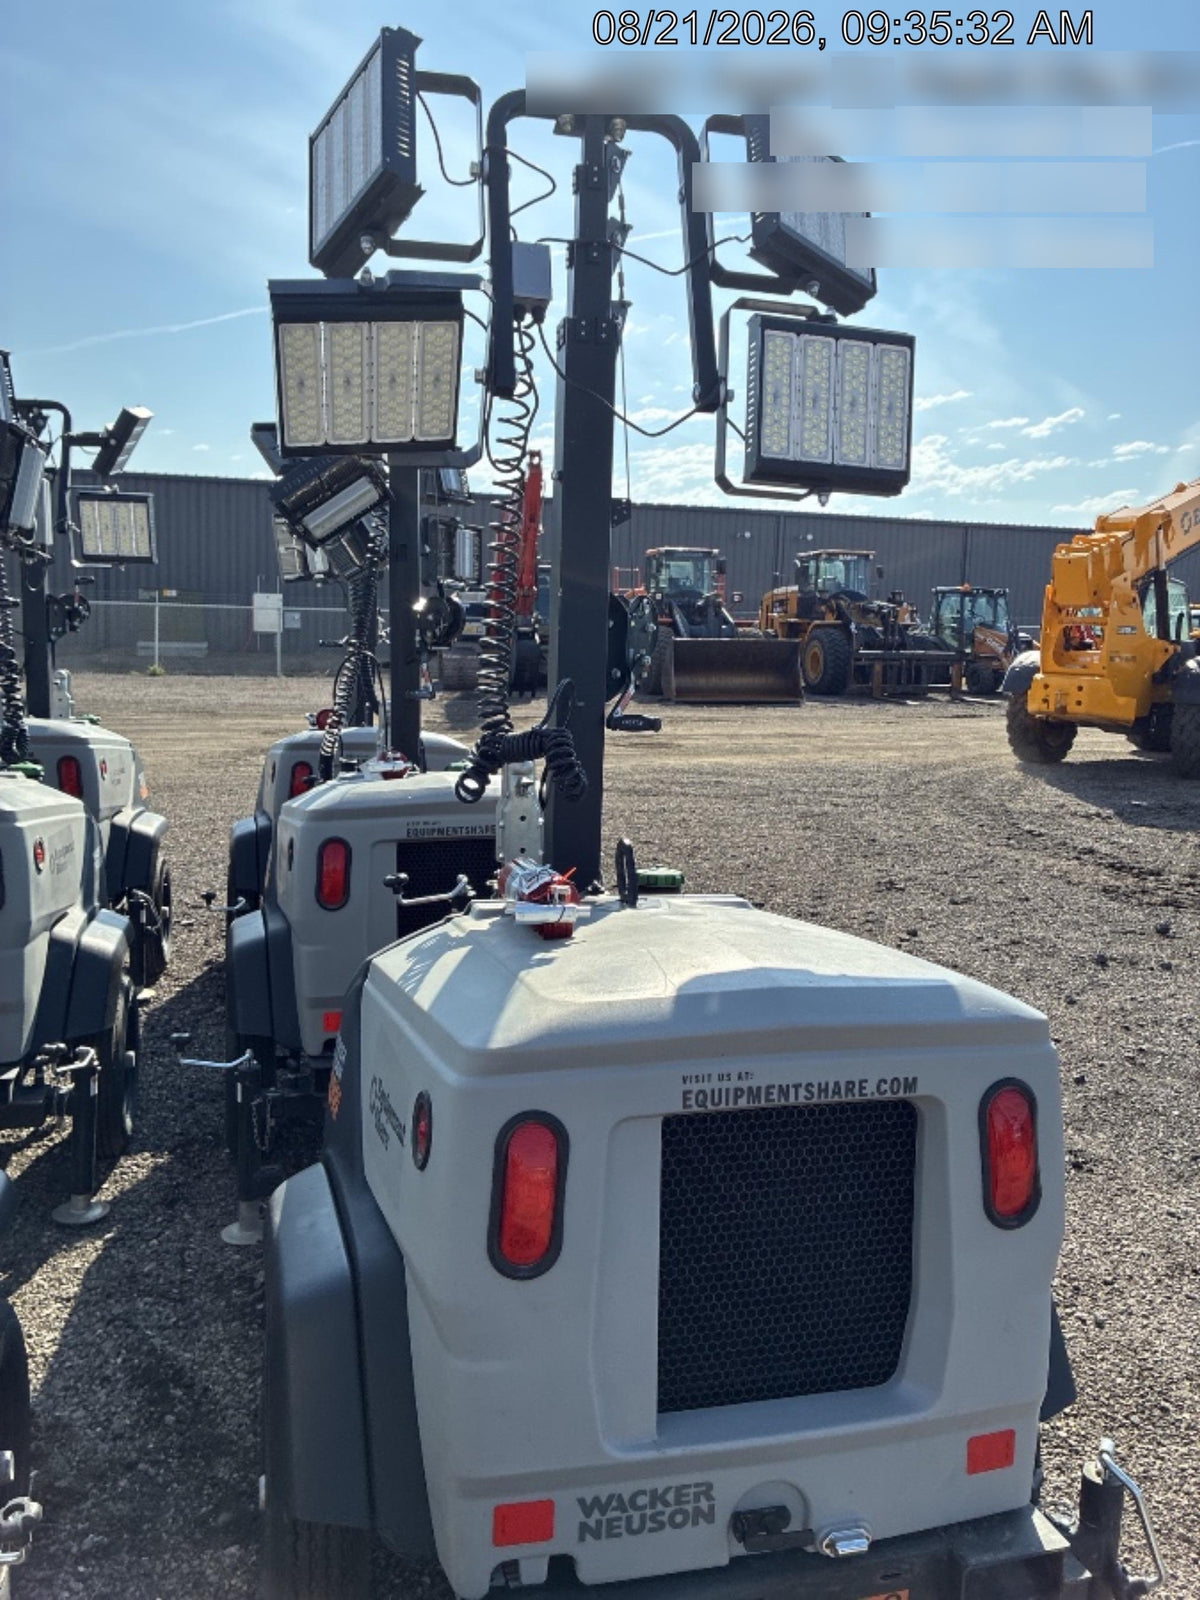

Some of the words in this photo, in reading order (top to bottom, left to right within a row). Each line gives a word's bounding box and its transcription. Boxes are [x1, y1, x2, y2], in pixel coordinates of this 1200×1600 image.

[682, 1074, 712, 1085] VISIT
[718, 1072, 731, 1082] US
[737, 1071, 754, 1081] AT:
[682, 1076, 918, 1110] EQUIPMENTSHARE.COM
[576, 1481, 716, 1519] WACKER
[577, 1503, 716, 1543] NEUSON
